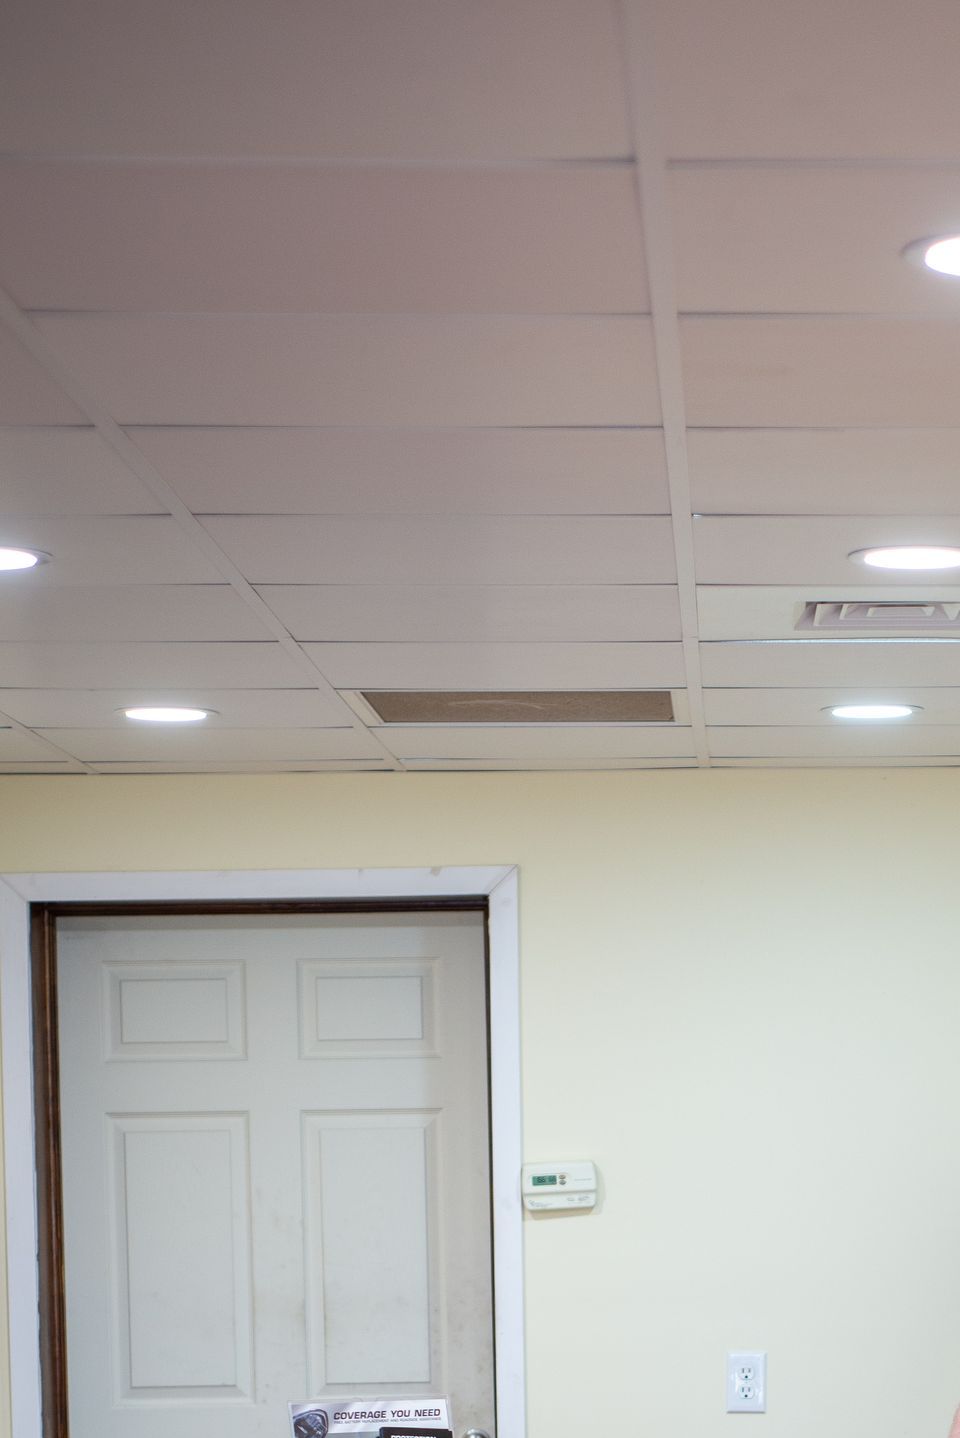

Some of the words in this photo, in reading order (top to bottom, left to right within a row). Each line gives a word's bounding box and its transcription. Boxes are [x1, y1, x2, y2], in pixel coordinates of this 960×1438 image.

[333, 1410, 387, 1420] COVERAGE
[390, 1409, 411, 1418] YOU
[414, 1408, 441, 1417] NEED
